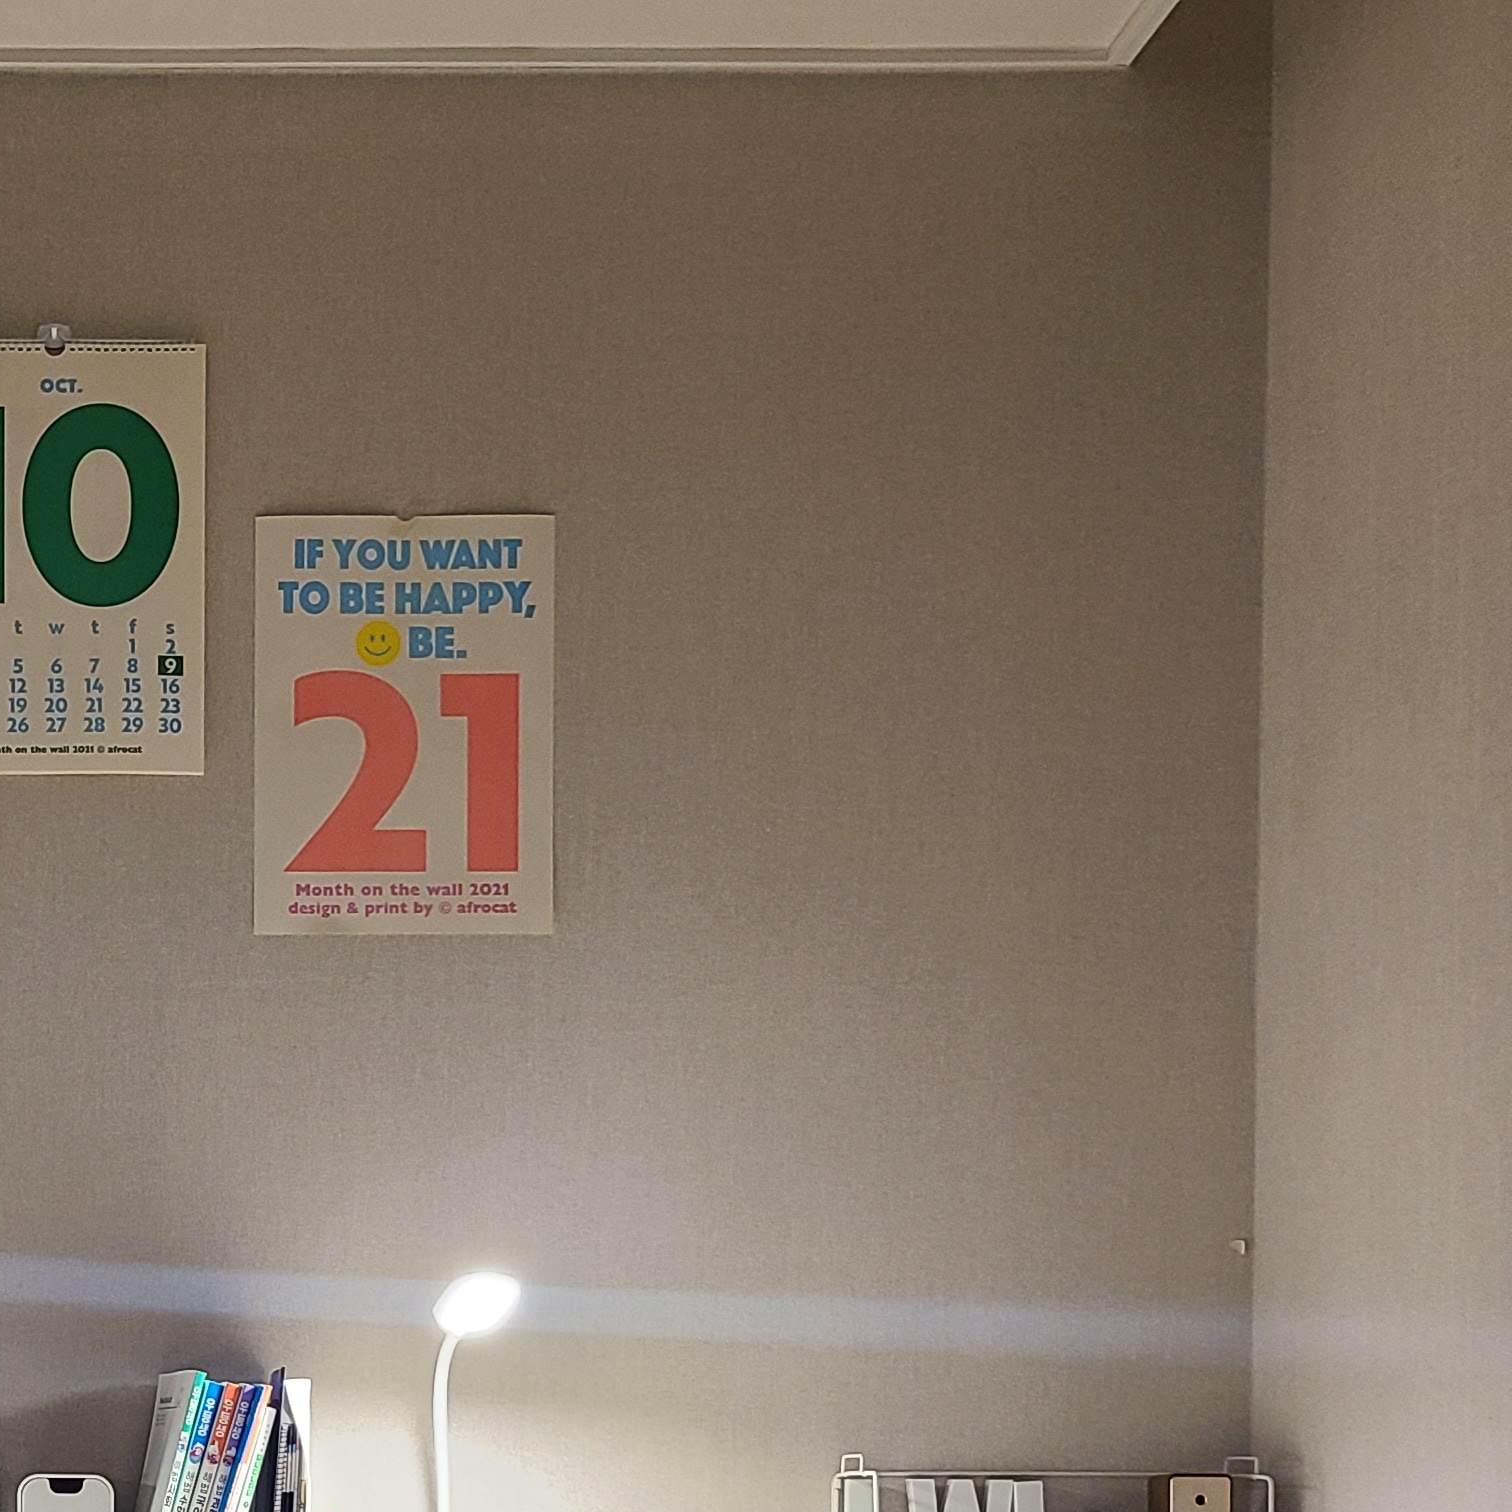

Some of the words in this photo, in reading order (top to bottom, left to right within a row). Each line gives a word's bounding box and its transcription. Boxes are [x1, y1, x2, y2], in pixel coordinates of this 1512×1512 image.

[39, 378, 84, 394] OCT.
[293, 539, 324, 570] IF
[332, 539, 411, 570] YOU
[419, 539, 522, 570] WANT
[278, 581, 330, 614] TO
[339, 582, 385, 614] BE
[394, 581, 537, 618] HAPPY,
[15, 619, 23, 635] t
[49, 623, 64, 635] w
[91, 619, 99, 635] t
[129, 619, 137, 635] f
[165, 623, 176, 635] s
[129, 638, 137, 654] 1
[165, 639, 177, 654] 2
[408, 626, 467, 659] BE.
[12, 658, 24, 674] 5
[50, 658, 63, 674] 6
[89, 658, 100, 674] 7
[126, 658, 138, 674] 8
[164, 658, 177, 674] 9
[9, 677, 27, 693] 12
[47, 677, 65, 693] 13
[85, 677, 104, 693] 14
[124, 677, 142, 693] 15
[162, 678, 180, 694] 16
[9, 697, 27, 713] 19
[45, 697, 67, 713] 20
[85, 697, 103, 713] 21
[122, 697, 143, 713] 22
[160, 697, 181, 714] 23
[7, 717, 29, 733] 26
[46, 717, 66, 733] 27
[83, 717, 105, 733] 28
[122, 717, 143, 733] 29
[159, 717, 182, 734] 30
[15, 746, 28, 754] on
[30, 745, 47, 754] the
[50, 745, 70, 754] wall
[107, 745, 143, 754] afrocat
[284, 669, 520, 873] 21
[295, 883, 355, 897] Month
[361, 885, 383, 897] on
[390, 883, 420, 897] the
[426, 883, 463, 897] wall
[470, 883, 509, 897] 2021
[289, 902, 341, 919] design
[364, 902, 408, 918] print
[414, 902, 433, 918] by
[457, 901, 518, 914] afrocat
